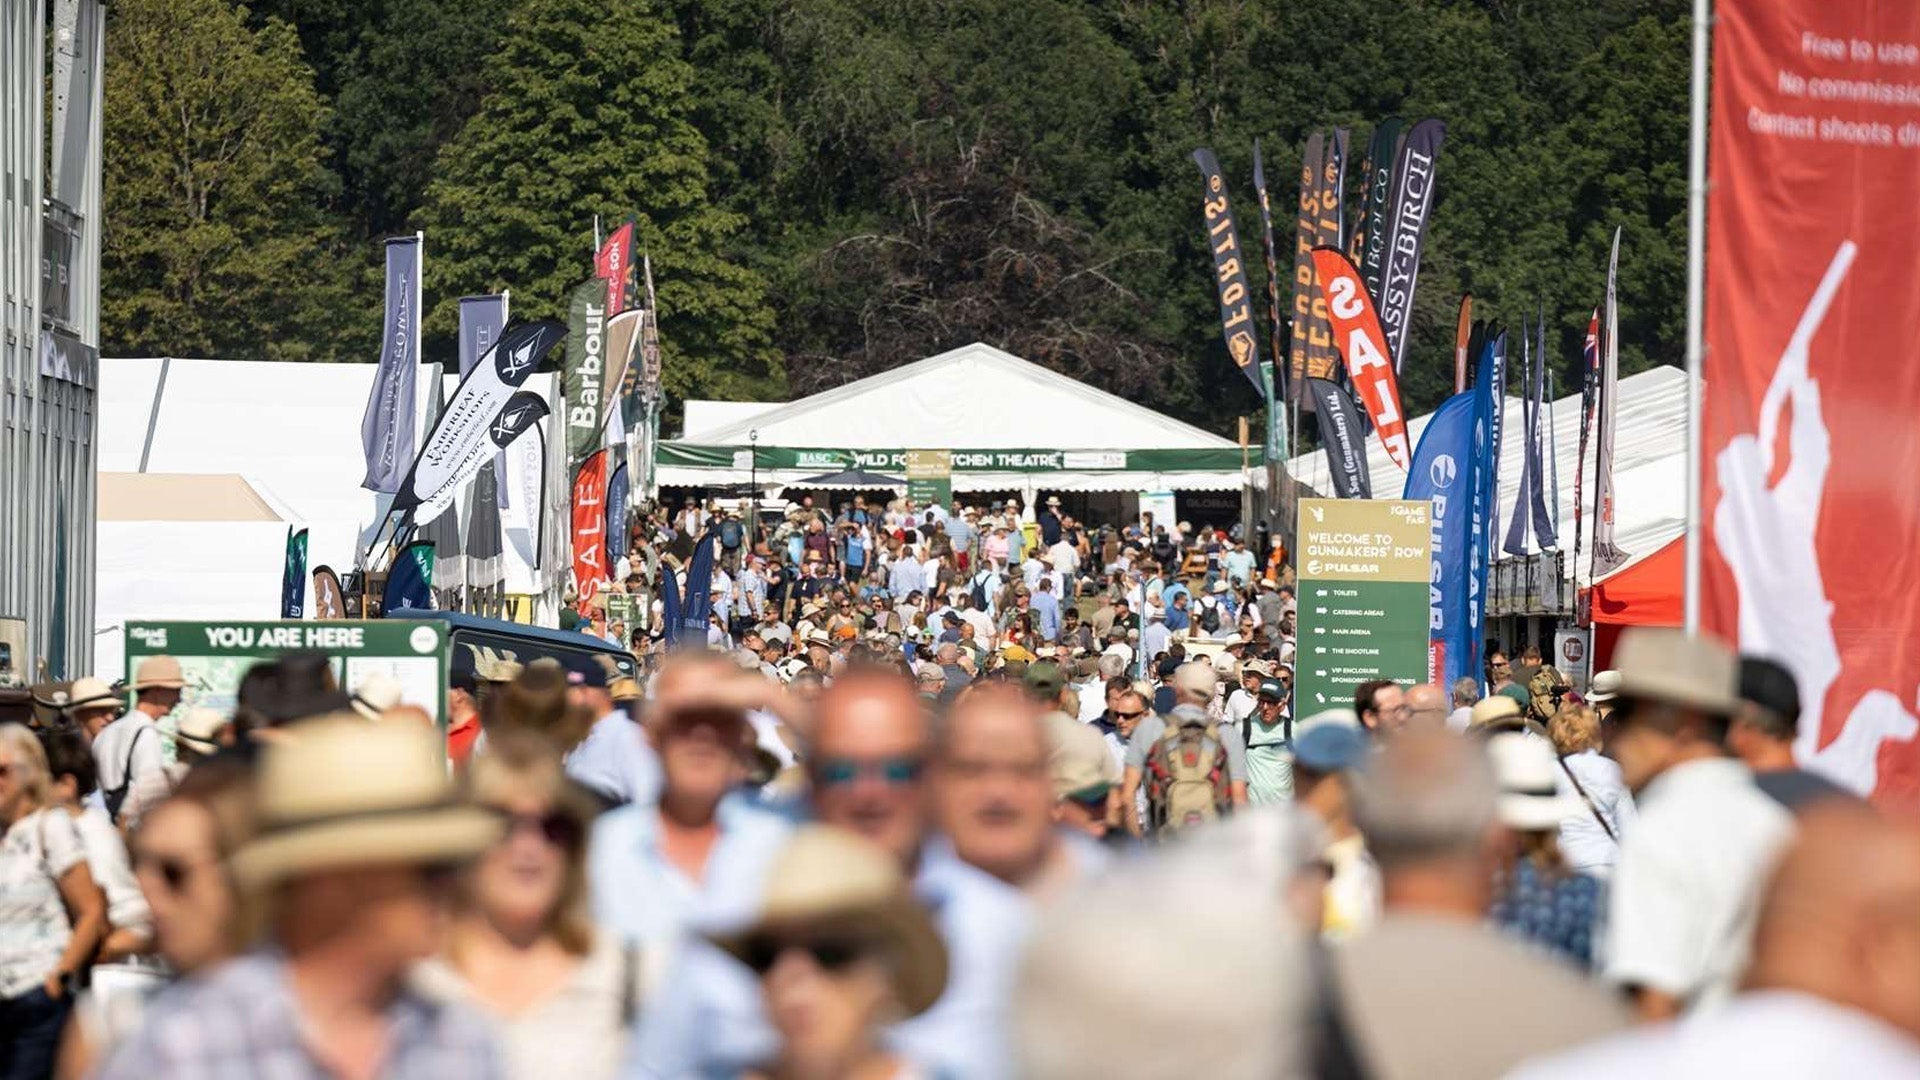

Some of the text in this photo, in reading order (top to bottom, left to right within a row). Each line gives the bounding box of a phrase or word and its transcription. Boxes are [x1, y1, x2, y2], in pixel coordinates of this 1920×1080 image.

[1802, 31, 1918, 64] Free to use
[1778, 70, 1806, 99] No
[1747, 106, 1816, 139] Contact
[1820, 116, 1893, 143] shoots
[426, 387, 475, 459] EMBERLEAF
[430, 390, 490, 466] WORKSHOPS
[855, 454, 888, 466] WILD
[999, 454, 1056, 467] THEATRE
[578, 484, 601, 601] SALE
[1307, 545, 1424, 559] GUNMAKERS' ROW
[1308, 531, 1393, 545] WELCOME TO
[1324, 563, 1379, 573] PULSAR
[204, 627, 365, 648] YOU ARE HERE
